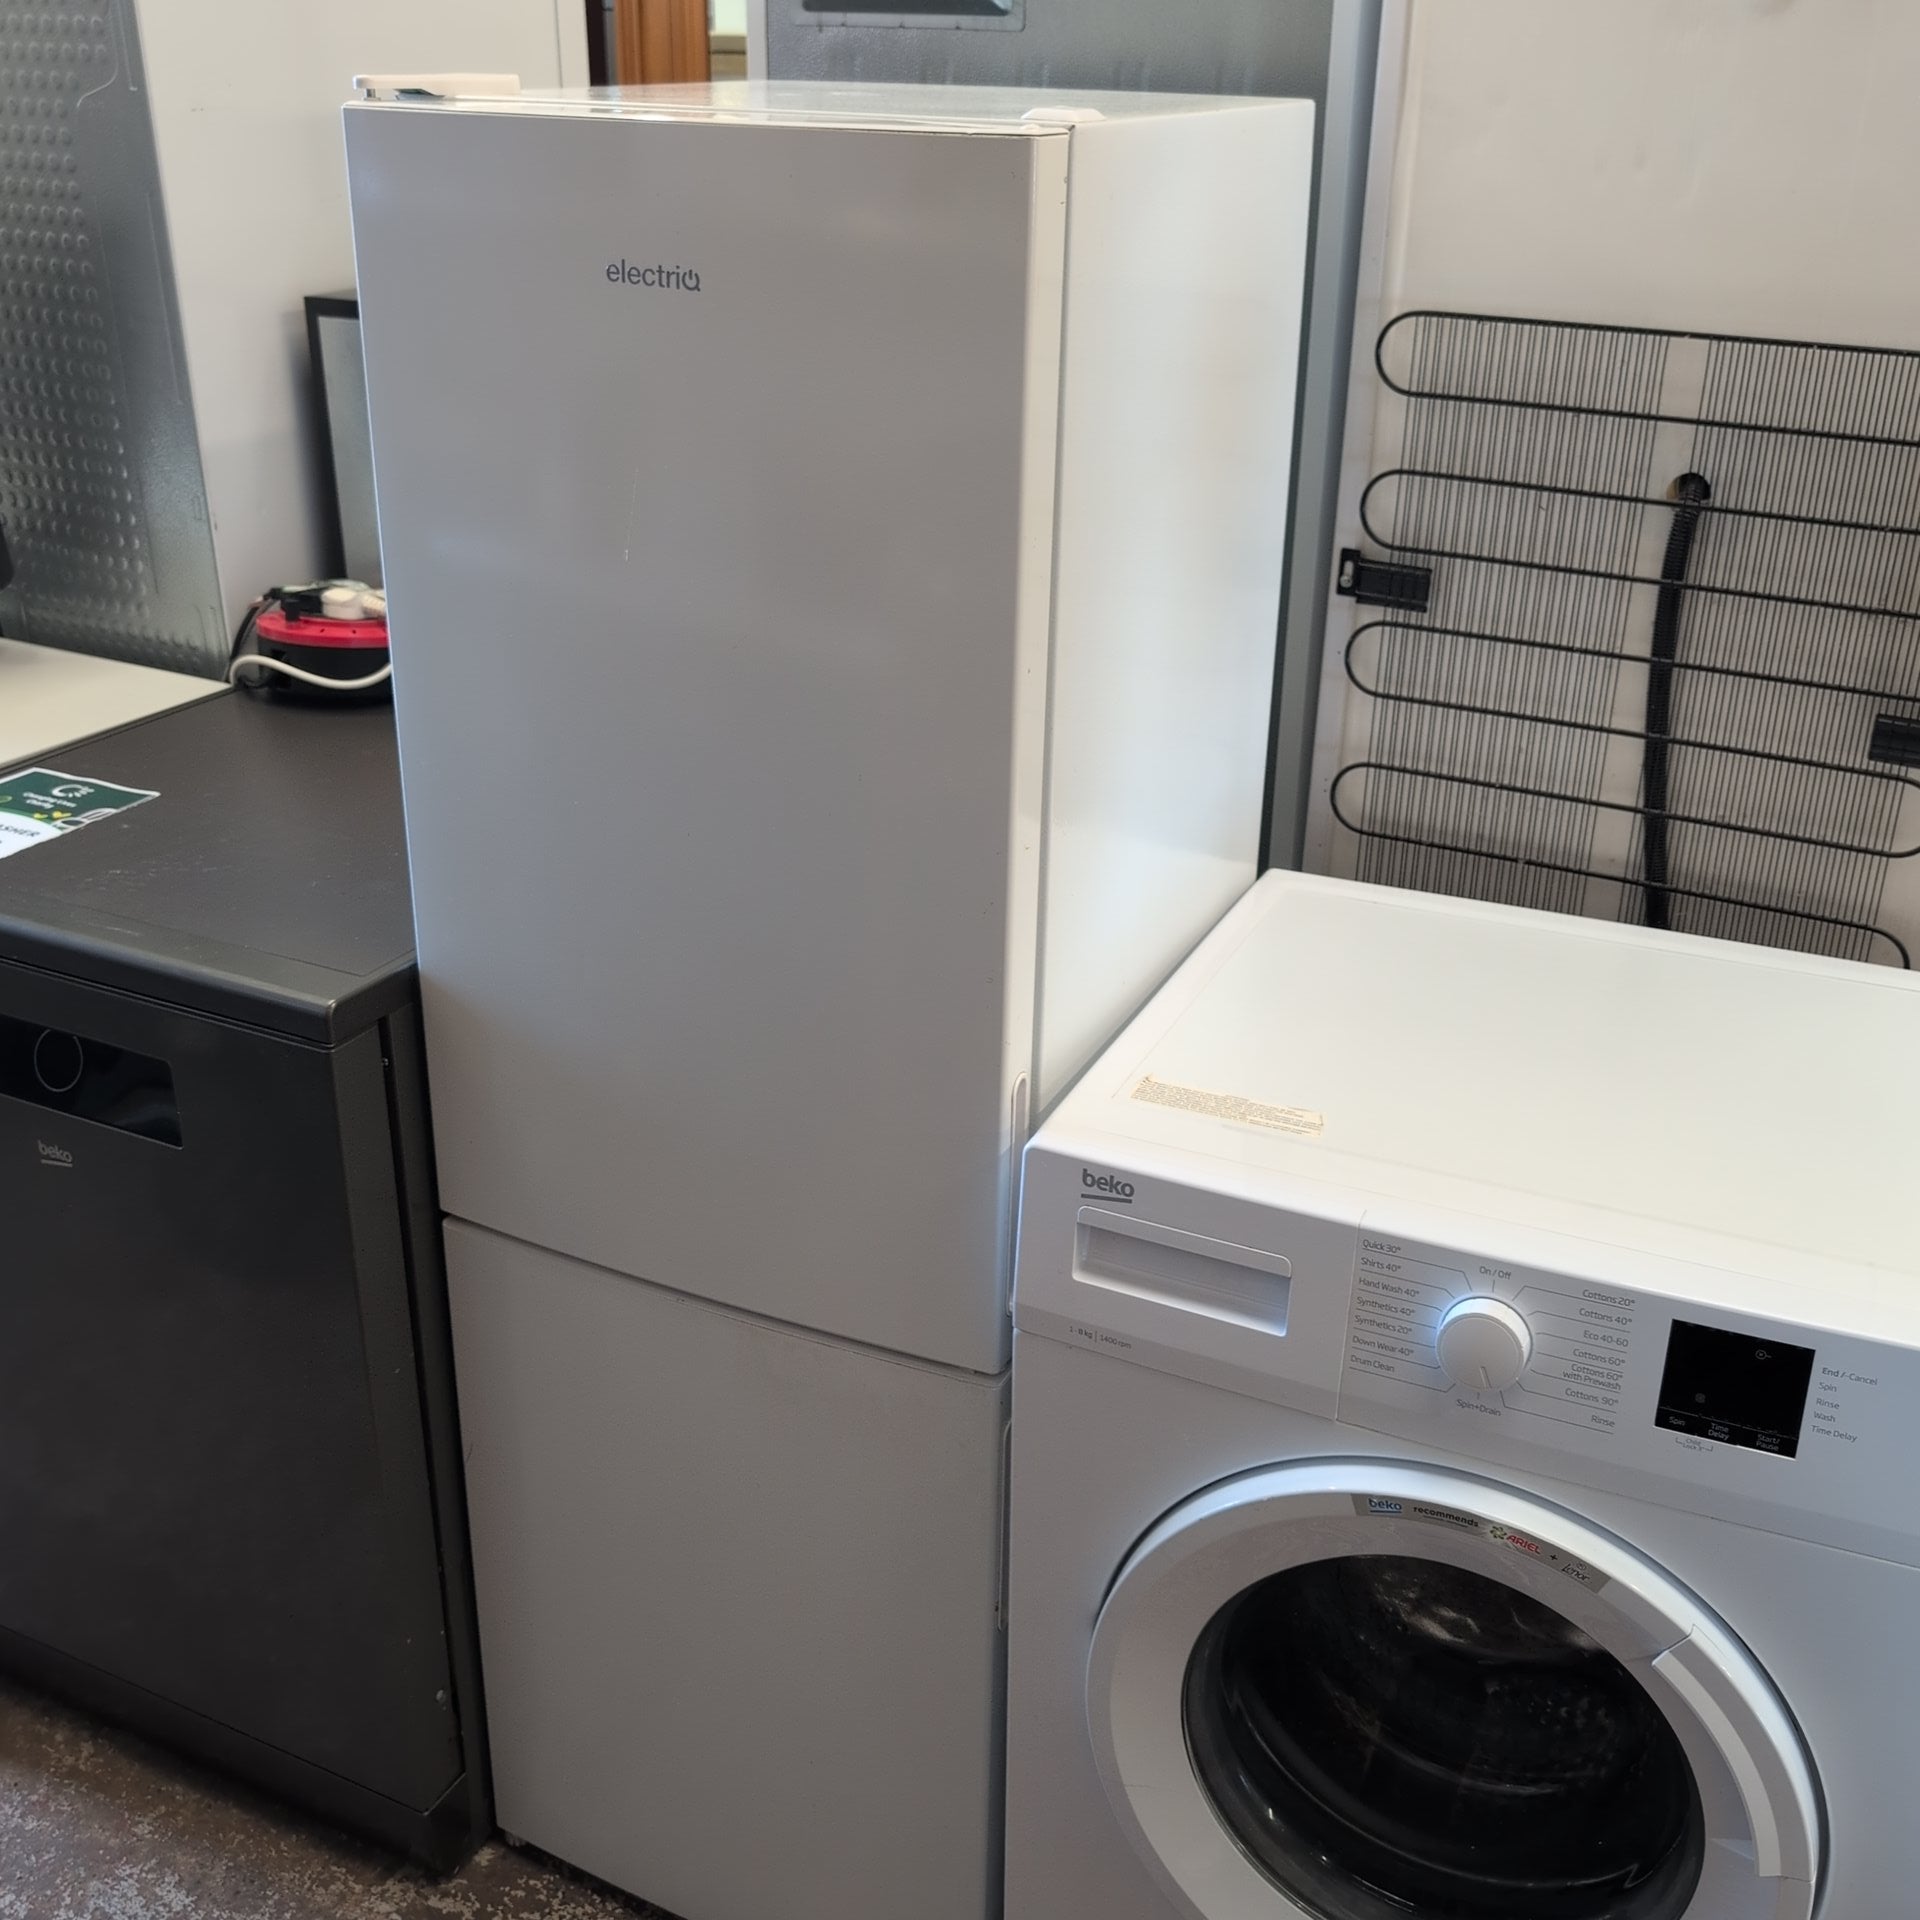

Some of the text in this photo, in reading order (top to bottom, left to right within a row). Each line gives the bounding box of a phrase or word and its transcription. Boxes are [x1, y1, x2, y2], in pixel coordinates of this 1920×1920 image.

[38, 1140, 73, 1163] beko
[1081, 1168, 1135, 1198] beko
[1363, 1239, 1386, 1251] Quick
[1361, 1257, 1384, 1270] Shirts
[1479, 1266, 1492, 1276] On
[1498, 1271, 1512, 1280] Off
[1359, 1277, 1380, 1289] Hand
[1381, 1282, 1403, 1295] Wash
[1583, 1289, 1617, 1304] Cottons
[1357, 1296, 1398, 1313] Synthetics
[1579, 1307, 1613, 1323] Cottons
[1354, 1315, 1396, 1332] Synthetics
[1353, 1336, 1375, 1348] Down
[1377, 1341, 1398, 1353] Wear
[1584, 1330, 1629, 1347] Eco 40-60
[1573, 1348, 1607, 1364] Cottons
[1351, 1355, 1395, 1373] Drum Clean
[1571, 1364, 1605, 1379] Cottons
[1822, 1367, 1840, 1378] End
[1563, 1371, 1621, 1391] with Prewash
[1818, 1381, 1837, 1392] Spin
[1565, 1388, 1599, 1403] Cottons
[1816, 1397, 1840, 1410] Rinse
[1592, 1415, 1615, 1427] Rinse
[1813, 1410, 1836, 1423] Wash
[1708, 1429, 1730, 1441] Delay
[1711, 1422, 1729, 1433] Time
[1811, 1424, 1858, 1443] Time Delay
[1368, 1498, 1402, 1511] beko
[1413, 1506, 1479, 1527] recommends
[1506, 1535, 1541, 1555] ARIEL
[1561, 1563, 1590, 1581] Lenor
